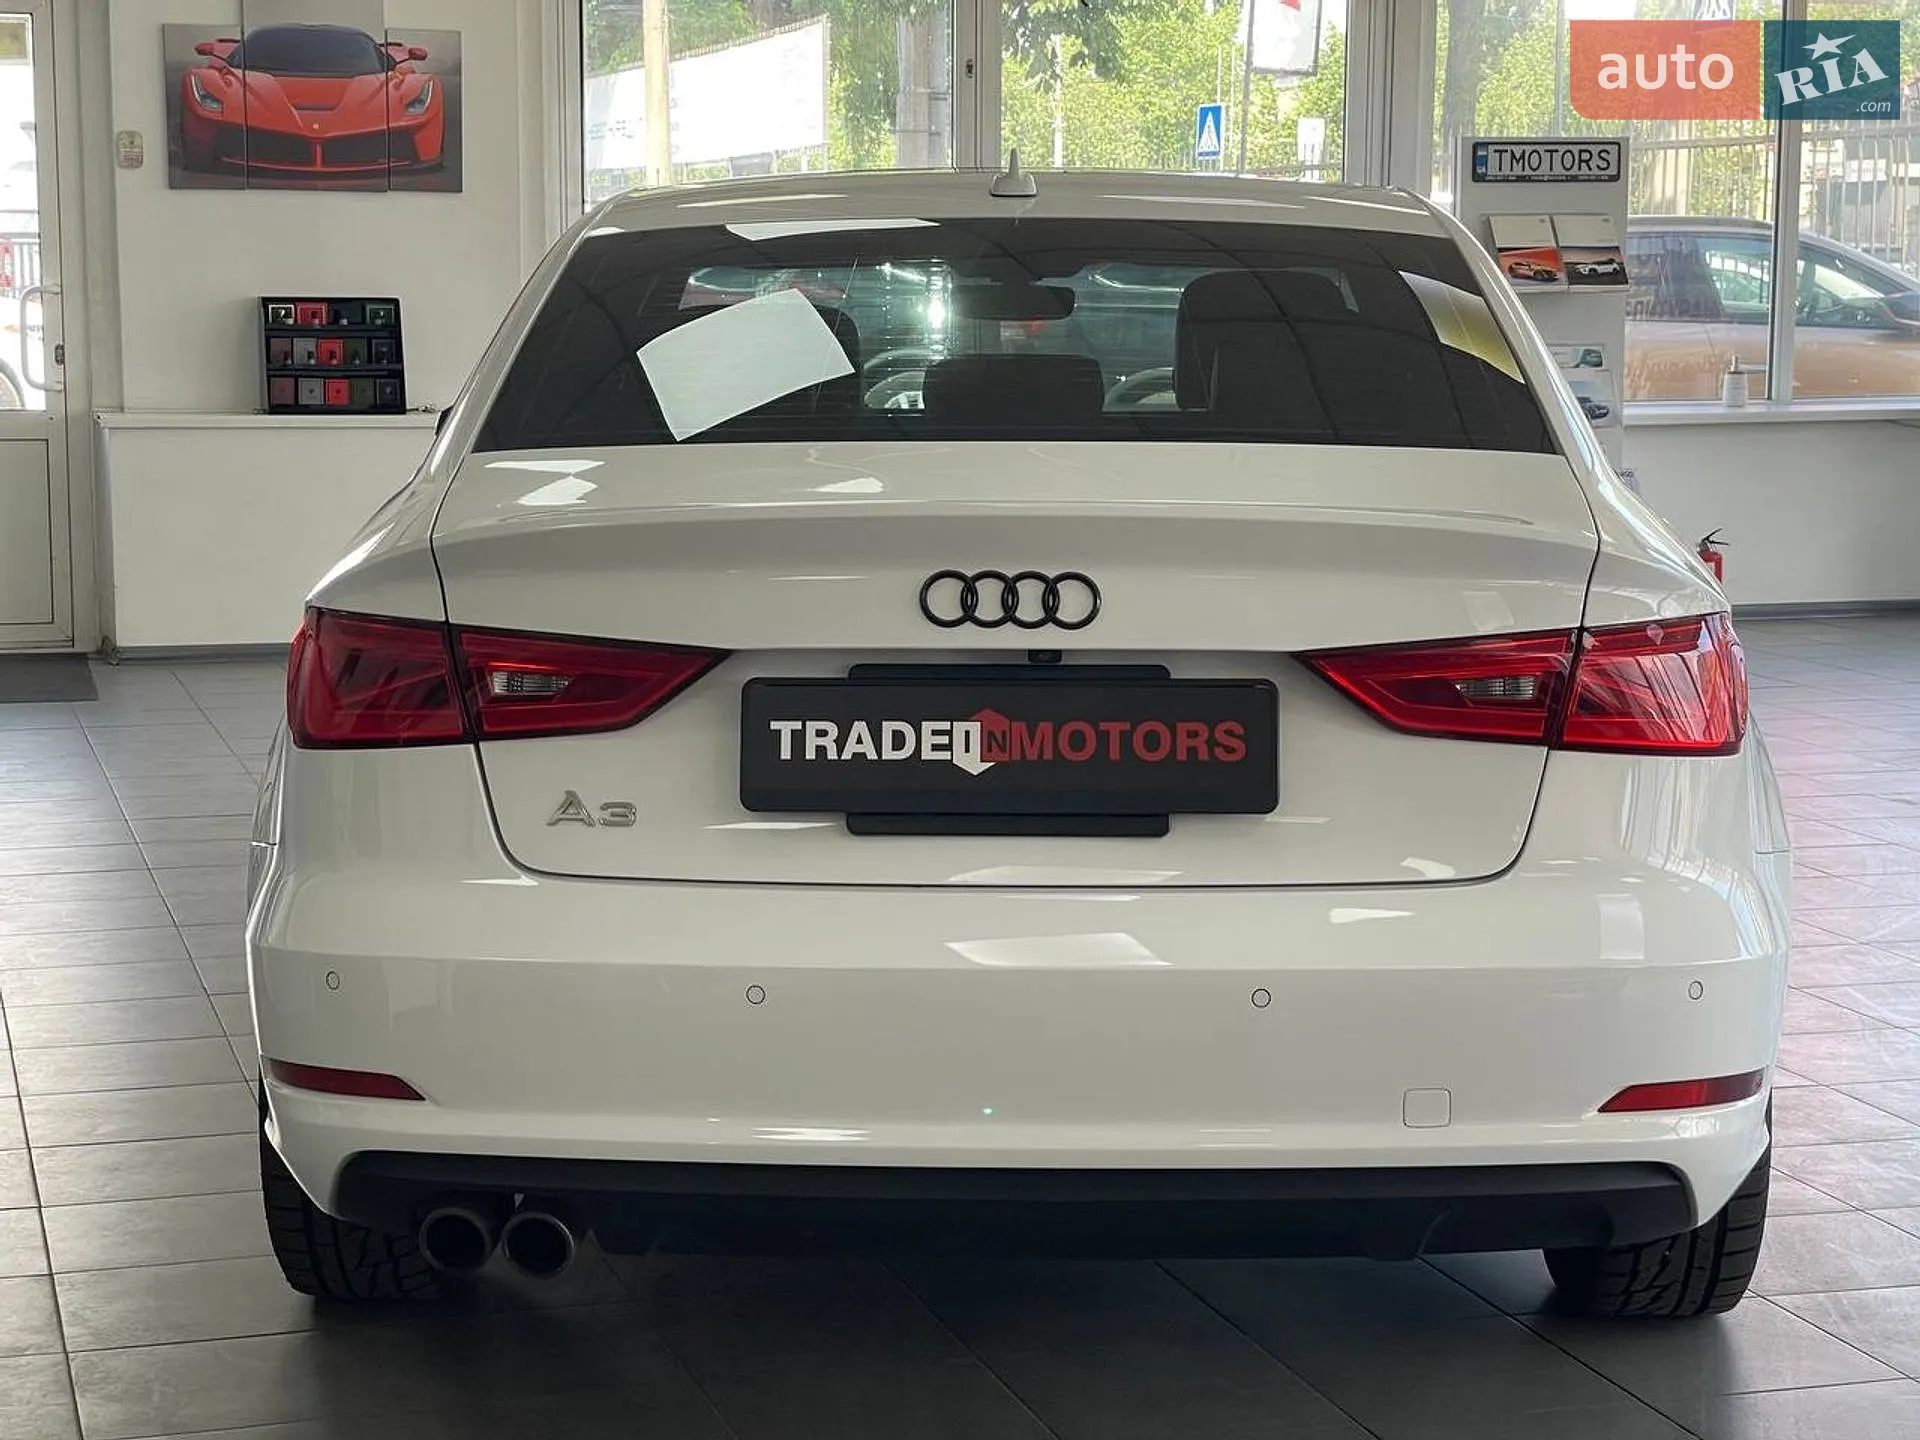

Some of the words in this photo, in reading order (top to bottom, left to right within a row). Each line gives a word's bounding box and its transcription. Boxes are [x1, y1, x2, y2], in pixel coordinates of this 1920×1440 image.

[1493, 148, 1612, 173] TMOTORS
[769, 720, 952, 761] TRADE
[1010, 720, 1248, 762] MOTORS
[546, 790, 637, 828] A3
